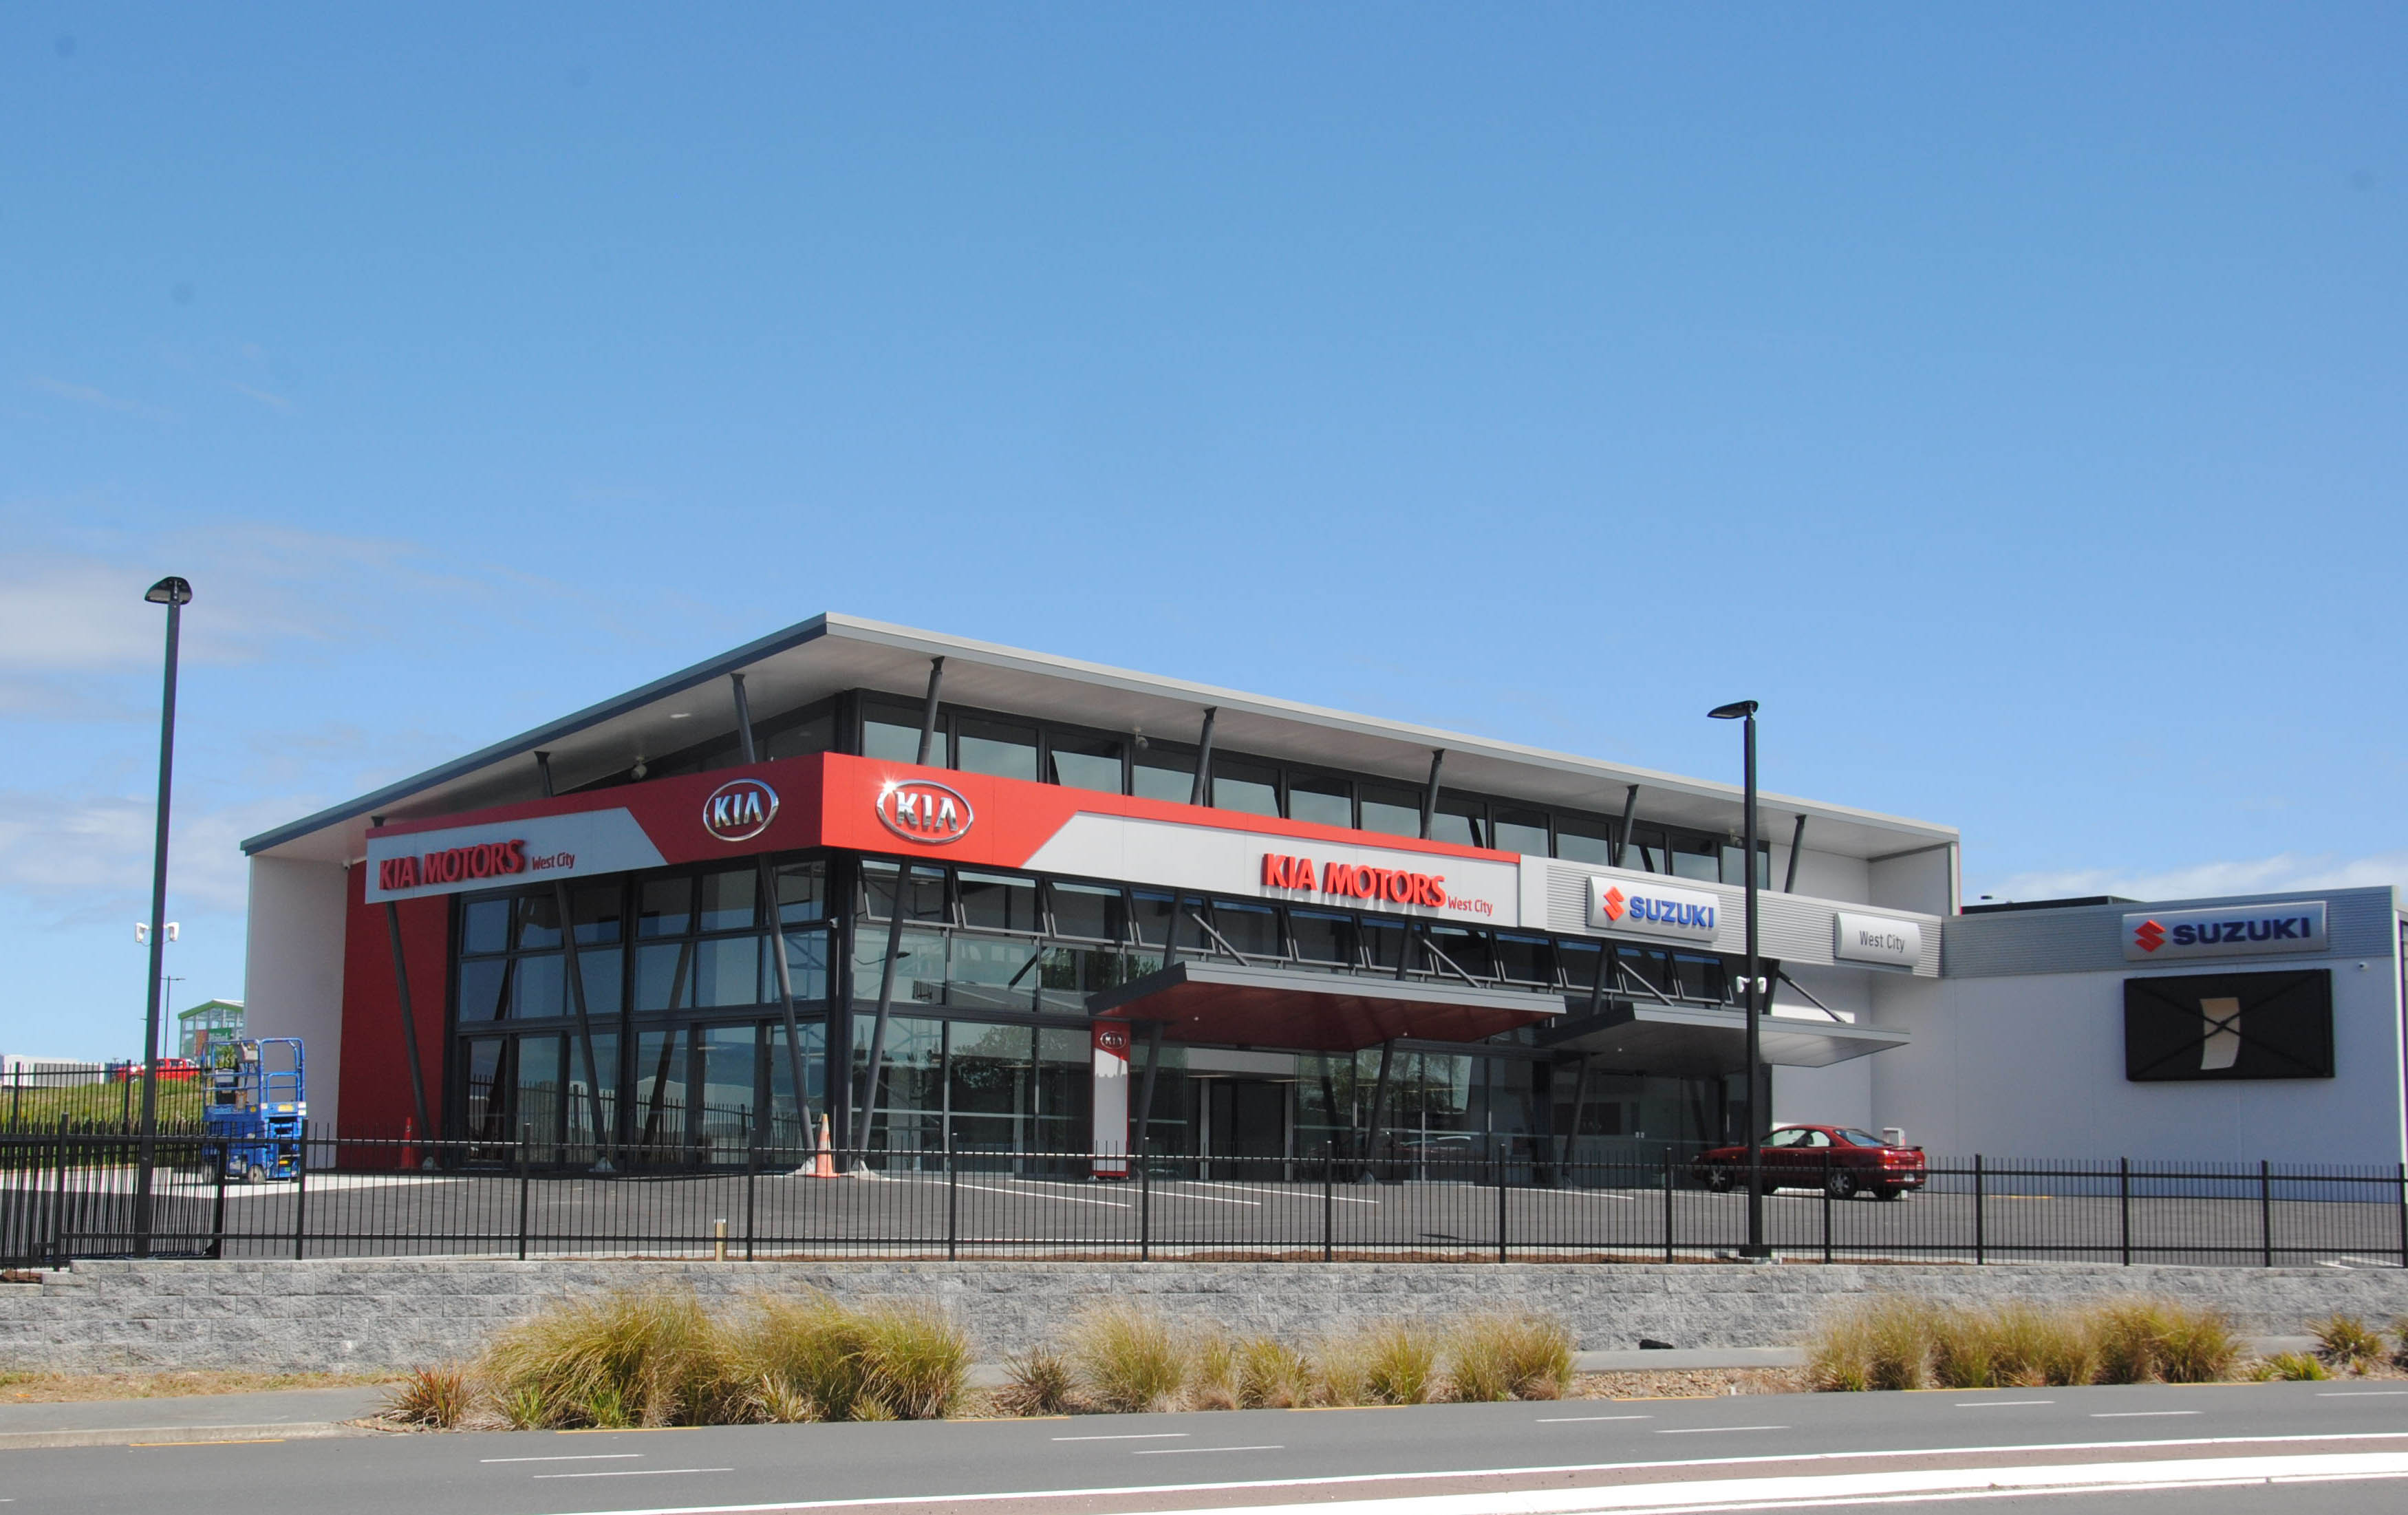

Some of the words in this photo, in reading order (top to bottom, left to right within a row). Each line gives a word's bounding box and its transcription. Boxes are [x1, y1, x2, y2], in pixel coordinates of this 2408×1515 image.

[713, 792, 764, 828] KIA
[895, 791, 959, 832] KIA
[379, 857, 419, 890] KIA
[422, 839, 525, 883] MOTORS
[532, 855, 555, 870] West
[557, 852, 575, 869] City
[1262, 853, 1317, 890] KIA
[1322, 861, 1446, 907] MOTORS
[1448, 896, 1472, 912] West
[1474, 899, 1494, 916] City
[1629, 896, 1714, 927] SUZUKI
[1860, 930, 1883, 948] West
[1886, 933, 1905, 954] City
[2173, 917, 2311, 945] SUZUKI
